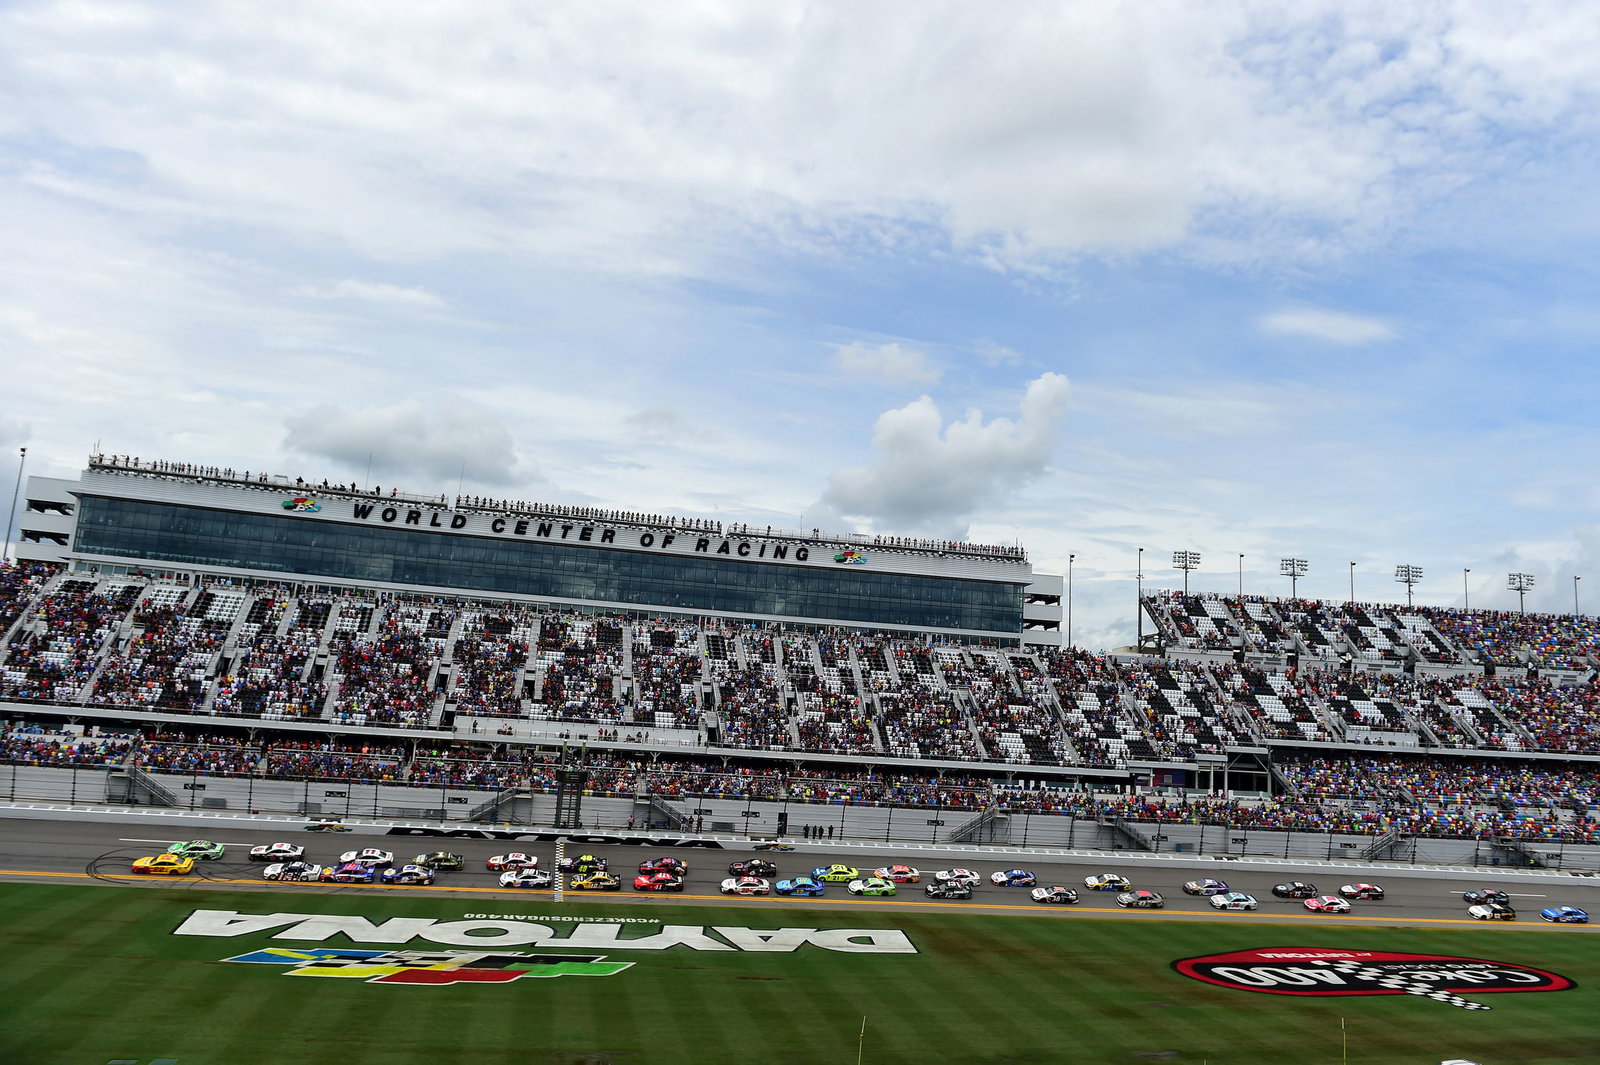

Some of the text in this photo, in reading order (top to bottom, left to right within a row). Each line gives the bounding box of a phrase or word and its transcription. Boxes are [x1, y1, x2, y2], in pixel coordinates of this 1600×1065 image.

[353, 503, 810, 562] WORLD CENTER OF RACING
[385, 826, 725, 849] DAYTONA
[580, 854, 593, 862] 48
[578, 865, 588, 873] 48
[463, 912, 661, 925] #COKEZEROSUGAR400
[173, 909, 918, 953] DAYTONA
[1211, 967, 1348, 986] 400
[1399, 969, 1541, 984] Coke
